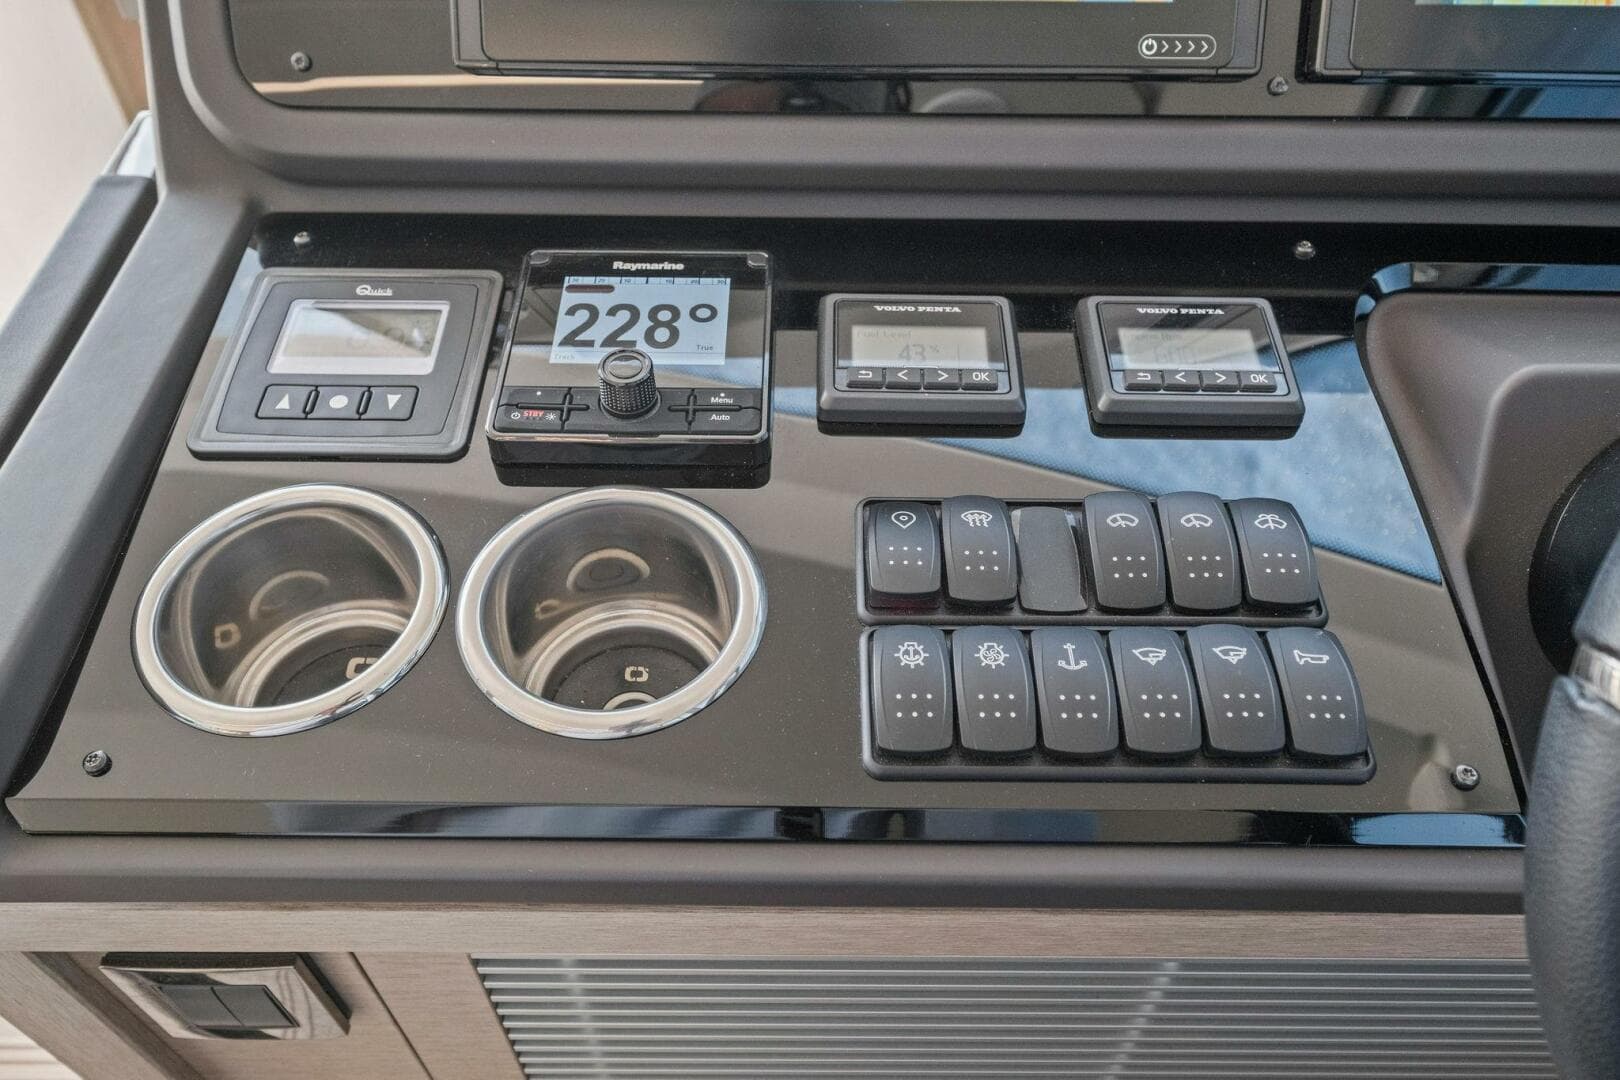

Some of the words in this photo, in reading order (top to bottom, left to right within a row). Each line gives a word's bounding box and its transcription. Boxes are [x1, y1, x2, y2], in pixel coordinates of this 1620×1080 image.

[613, 261, 684, 271] Raymarine
[917, 305, 962, 313] PENTA
[1180, 307, 1225, 315] PENTA
[972, 371, 990, 382] OK
[1250, 373, 1268, 384] OK
[711, 396, 734, 404] Menu
[710, 413, 730, 421] Auto
